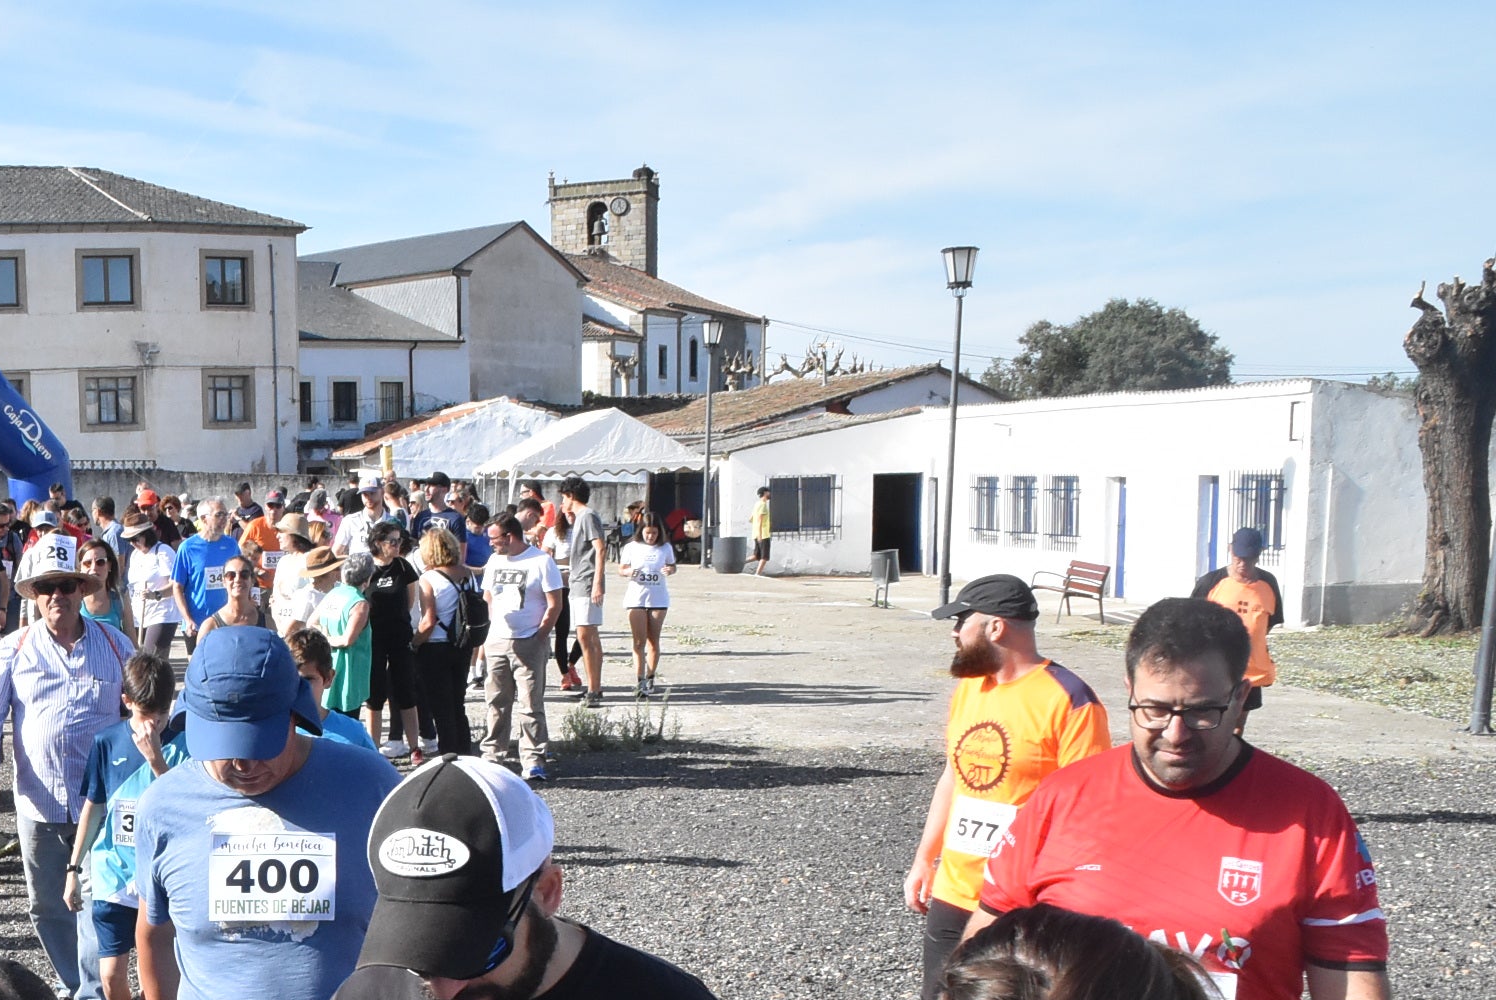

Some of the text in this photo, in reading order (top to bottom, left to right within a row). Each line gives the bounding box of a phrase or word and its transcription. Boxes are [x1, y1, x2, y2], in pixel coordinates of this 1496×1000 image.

[4, 405, 51, 460] Caja Duero
[639, 573, 659, 582] 330
[957, 817, 999, 841] 577
[221, 837, 267, 853] marcha
[405, 833, 452, 861] Dutch
[225, 858, 319, 894] 400
[214, 896, 331, 914] FUENTES DE BÉJAR
[1230, 890, 1248, 902] FS
